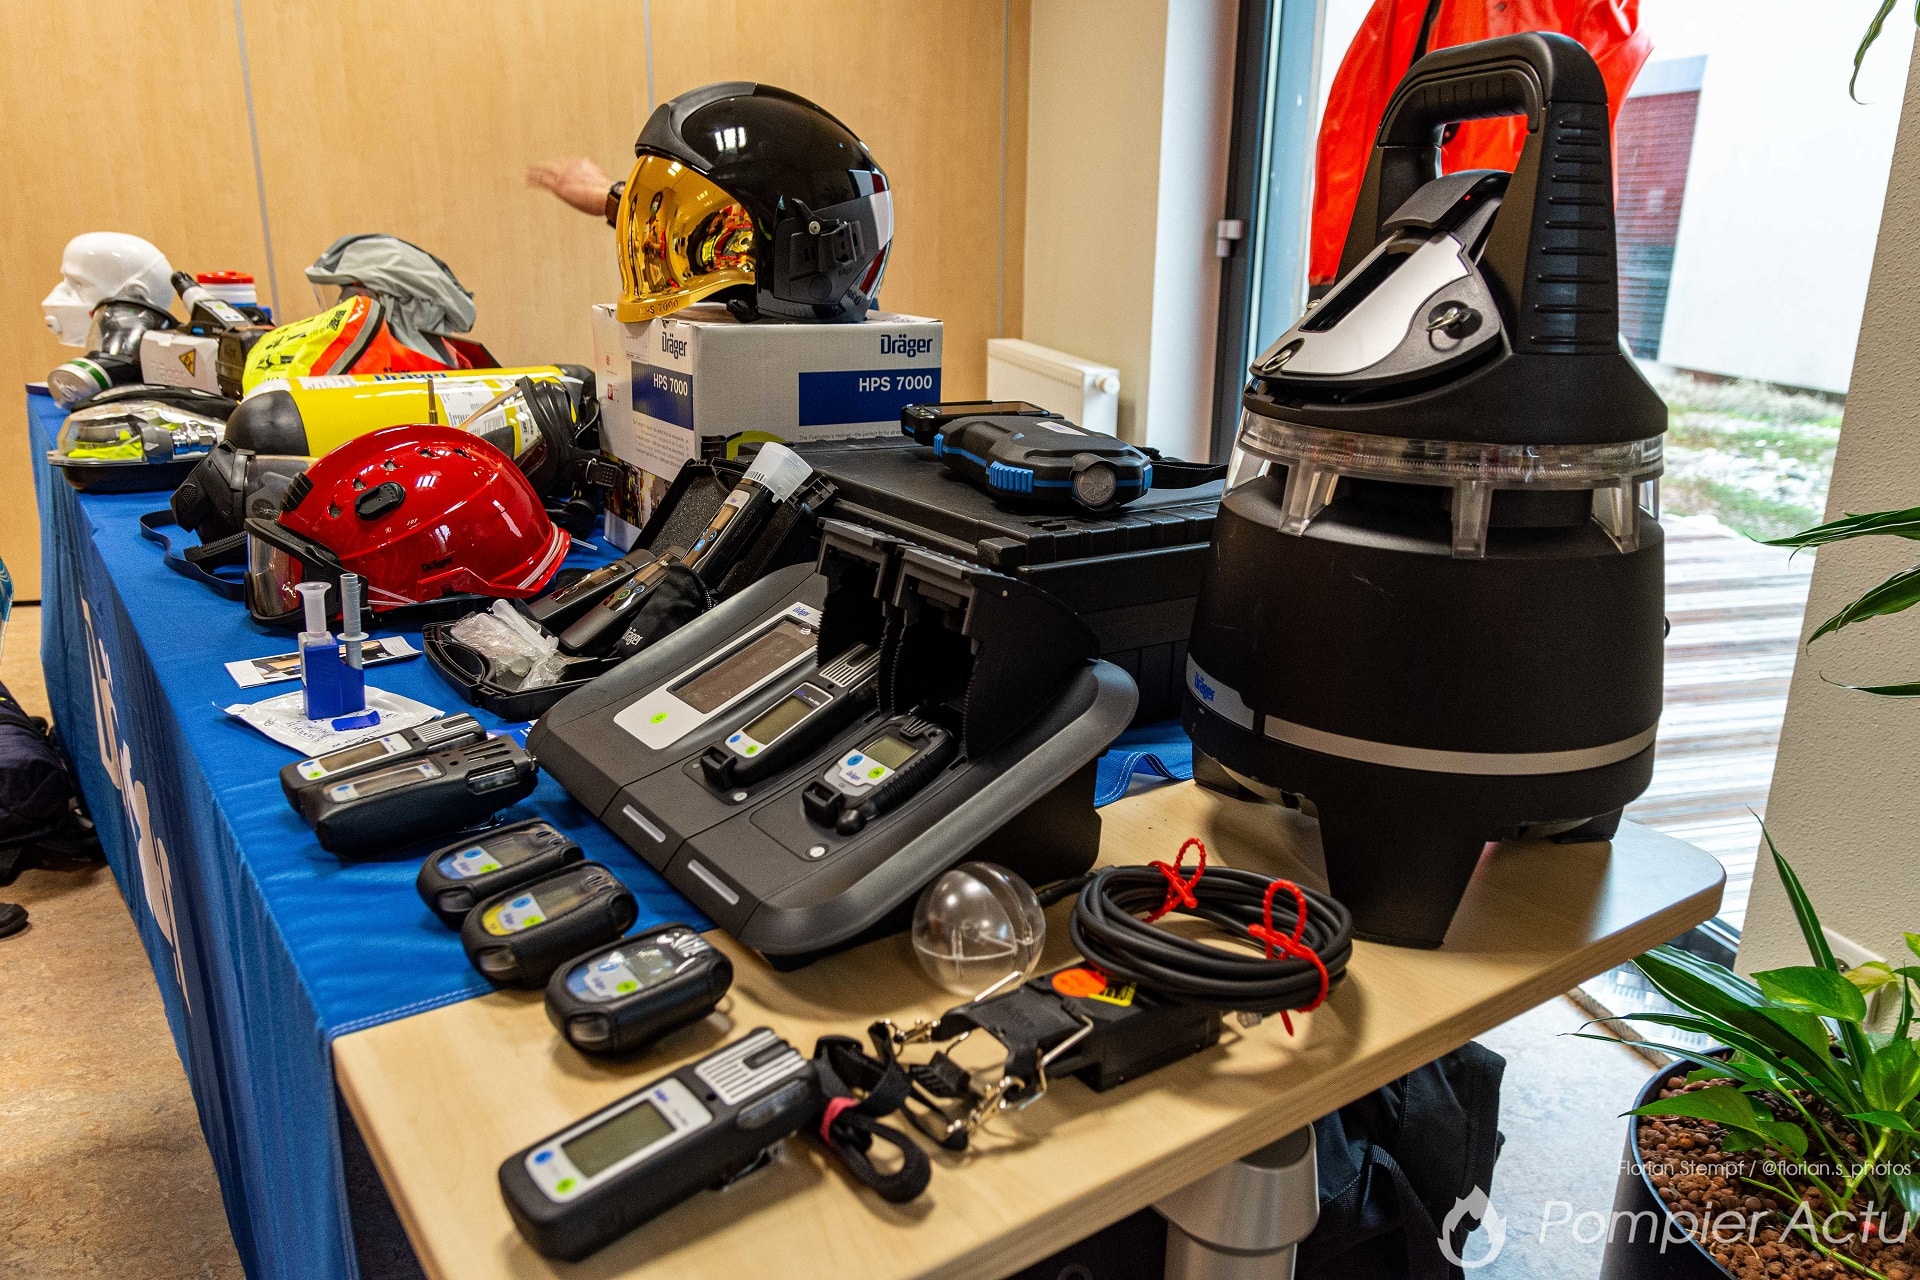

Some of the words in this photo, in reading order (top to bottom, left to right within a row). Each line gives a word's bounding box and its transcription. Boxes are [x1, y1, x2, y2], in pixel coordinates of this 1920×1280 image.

[656, 299, 679, 313] 7000
[661, 331, 688, 360] Dräger
[880, 333, 933, 358] Dräger
[653, 372, 668, 391] HPS
[669, 377, 689, 397] 7000
[858, 376, 891, 392] HPS
[896, 374, 933, 391] 7000
[1194, 671, 1216, 702] Dräger
